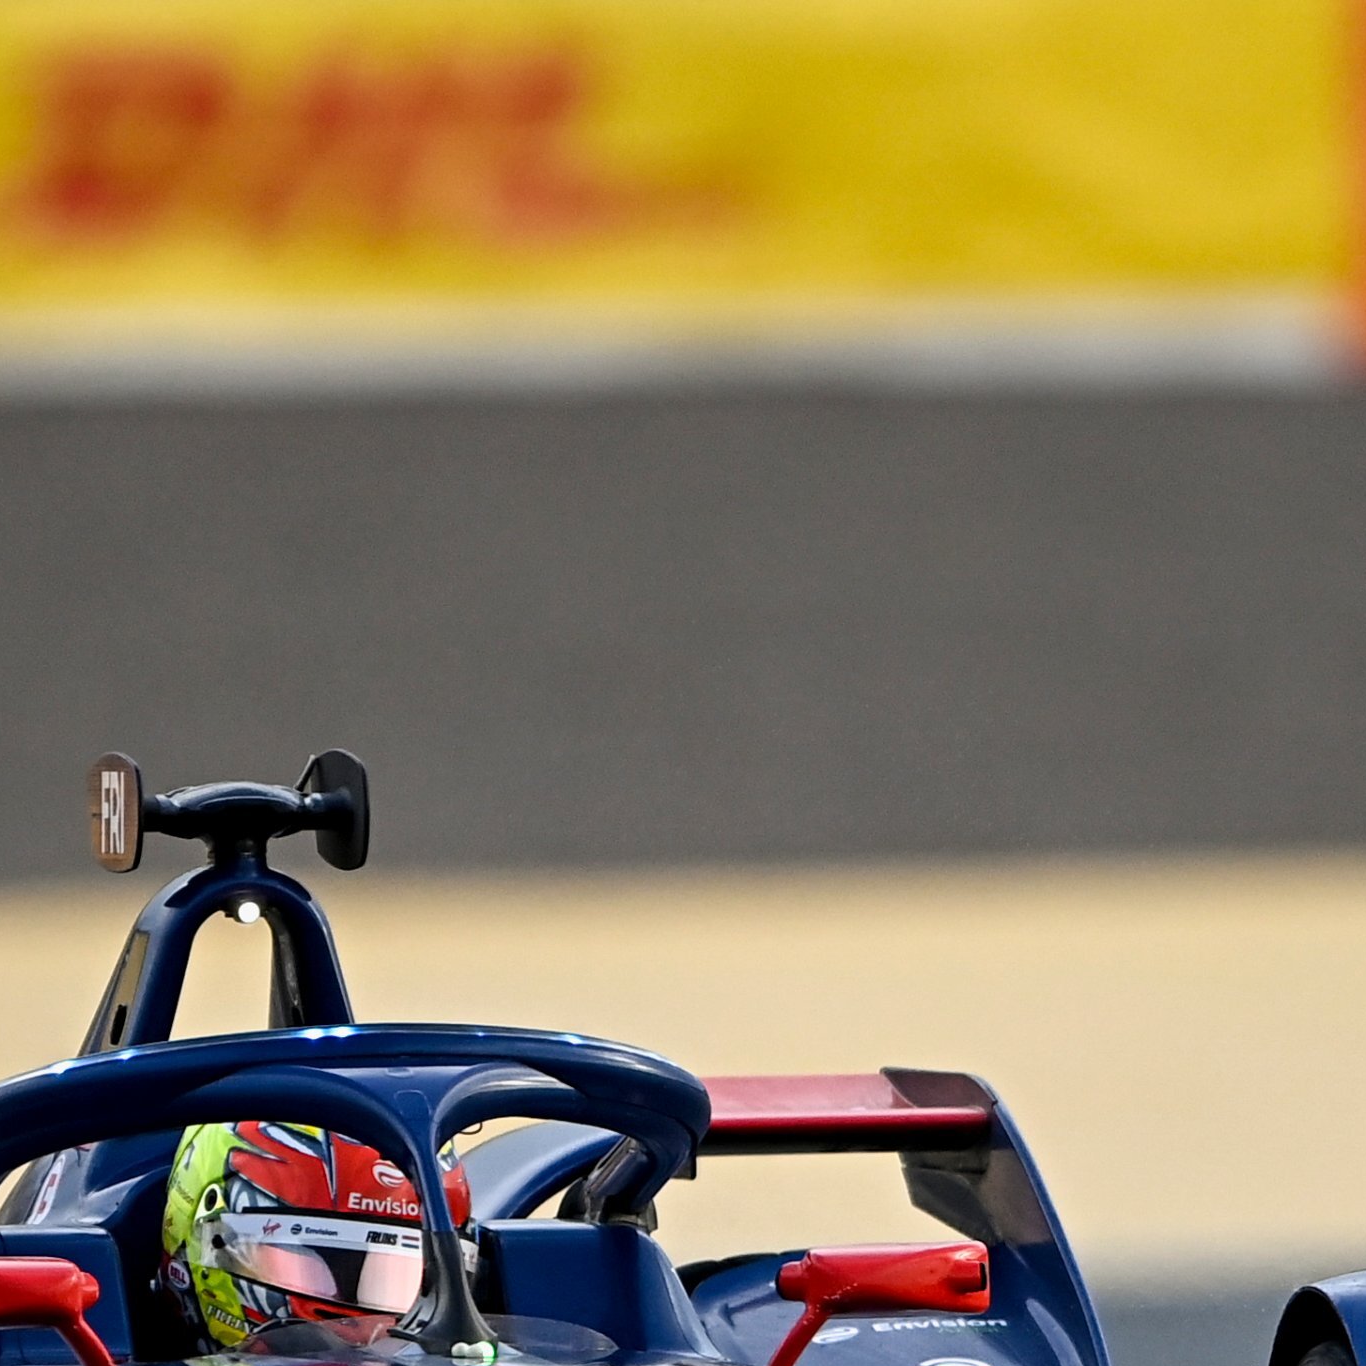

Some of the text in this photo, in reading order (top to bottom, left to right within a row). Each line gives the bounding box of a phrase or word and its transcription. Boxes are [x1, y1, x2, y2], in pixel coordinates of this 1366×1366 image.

[20, 45, 620, 240] DHL
[100, 770, 125, 855] FRI
[347, 1191, 422, 1216] Envisio
[872, 1318, 1008, 1333] Envision
